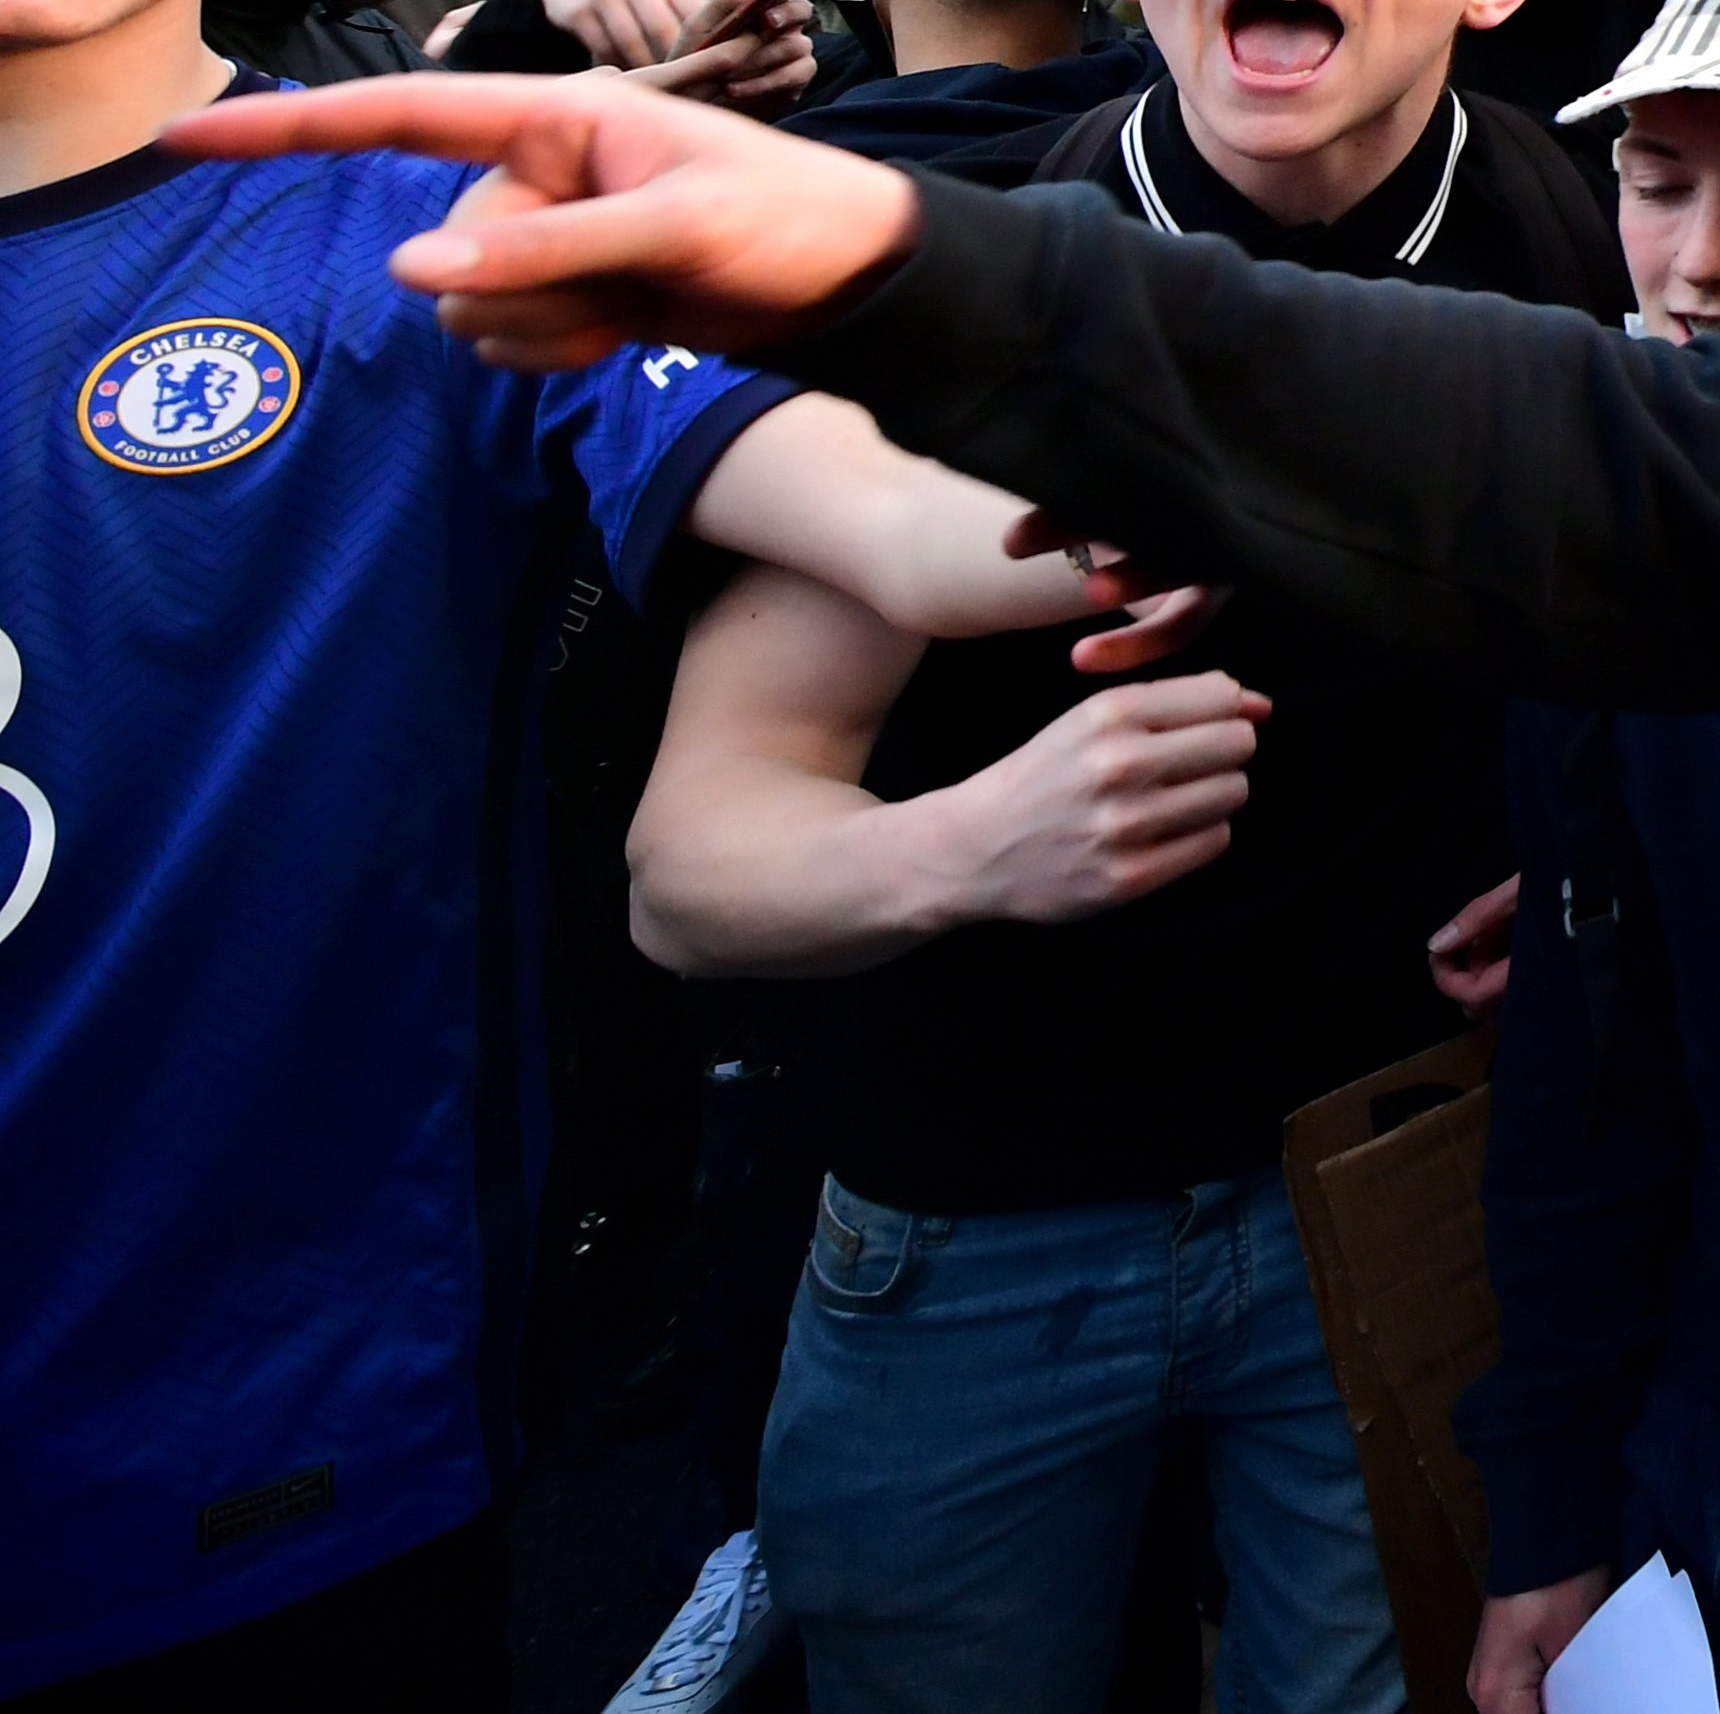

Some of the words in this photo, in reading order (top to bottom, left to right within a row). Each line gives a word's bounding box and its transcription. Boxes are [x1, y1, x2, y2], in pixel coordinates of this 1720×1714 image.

[129, 331, 261, 366] CHELSEA
[113, 440, 200, 464] FOOTBALL
[207, 428, 252, 456] CLUB
